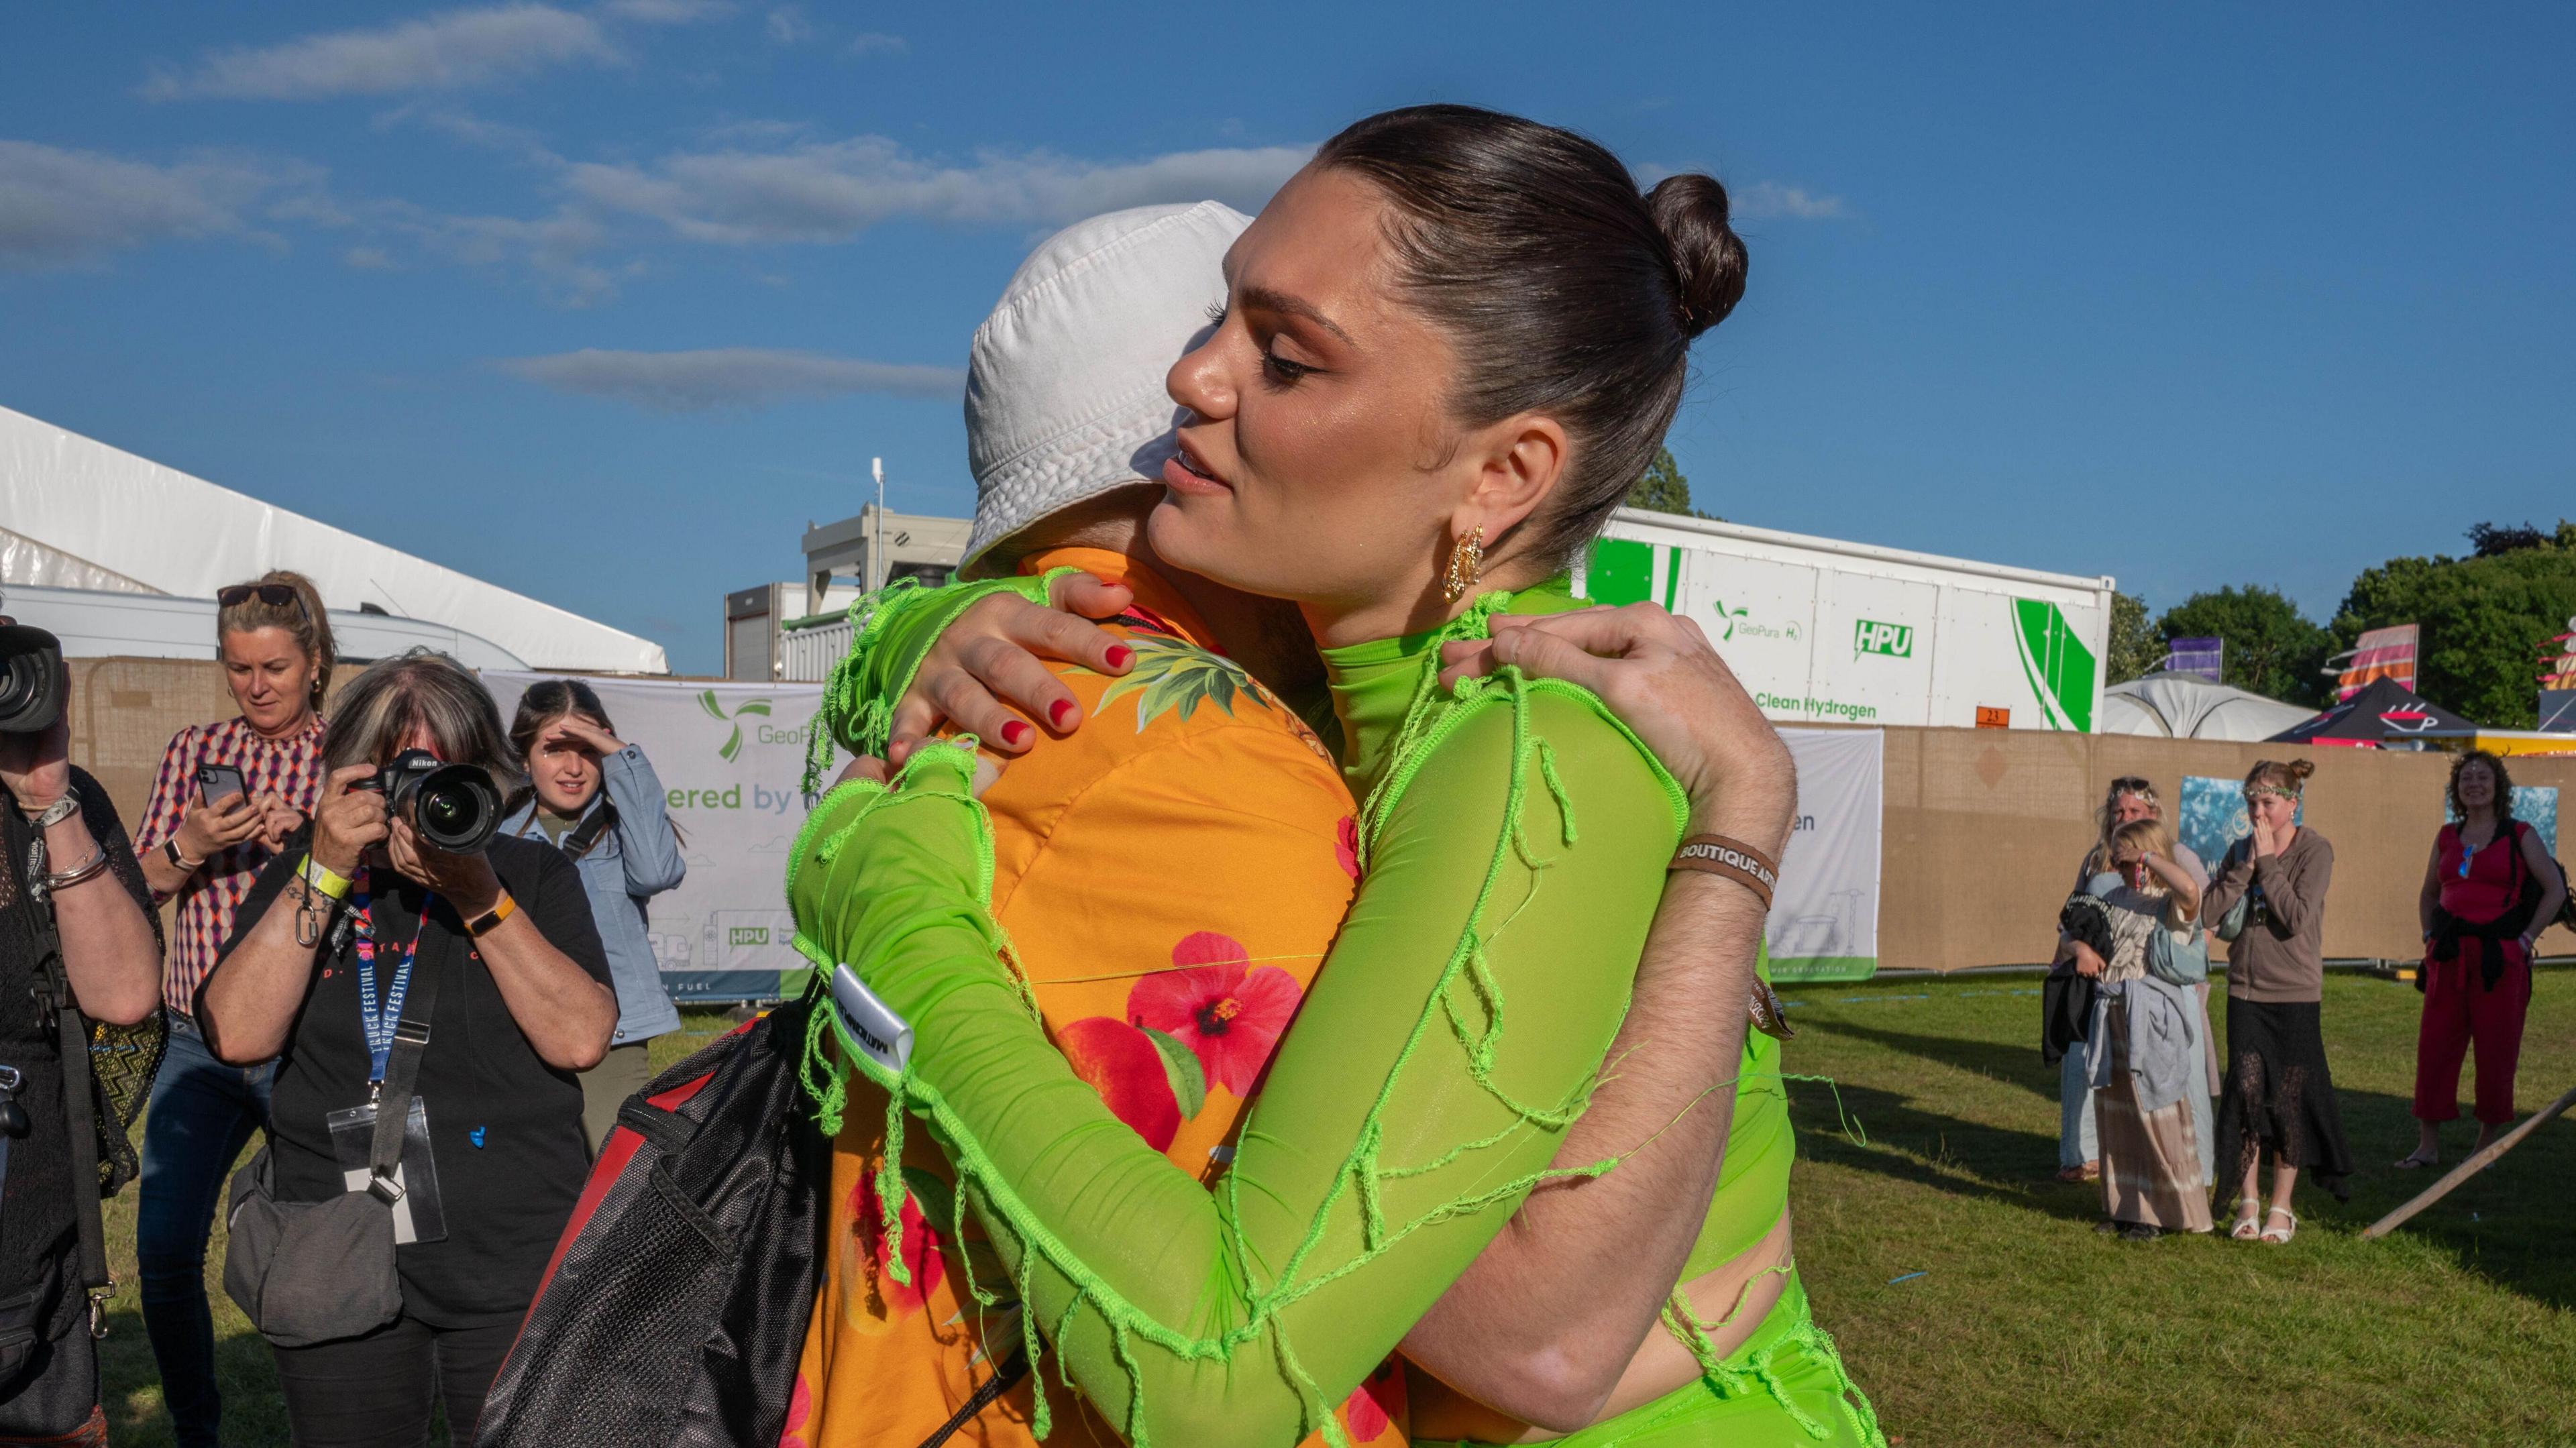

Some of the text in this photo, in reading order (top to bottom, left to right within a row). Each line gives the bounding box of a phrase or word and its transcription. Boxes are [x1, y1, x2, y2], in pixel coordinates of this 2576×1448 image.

[1739, 622, 1780, 639] GeoPura
[1856, 621, 1912, 655] HPU
[1755, 692, 1877, 721] Clean Hydrogen
[412, 759, 437, 767] Nikon
[754, 783, 792, 816] by
[1679, 844, 1759, 875] BOUTIQUE
[730, 929, 768, 946] HPU
[386, 962, 411, 1012] FESTIVAL
[678, 983, 711, 991] FUEL
[360, 965, 382, 1054] TRUCK FESTIVAL
